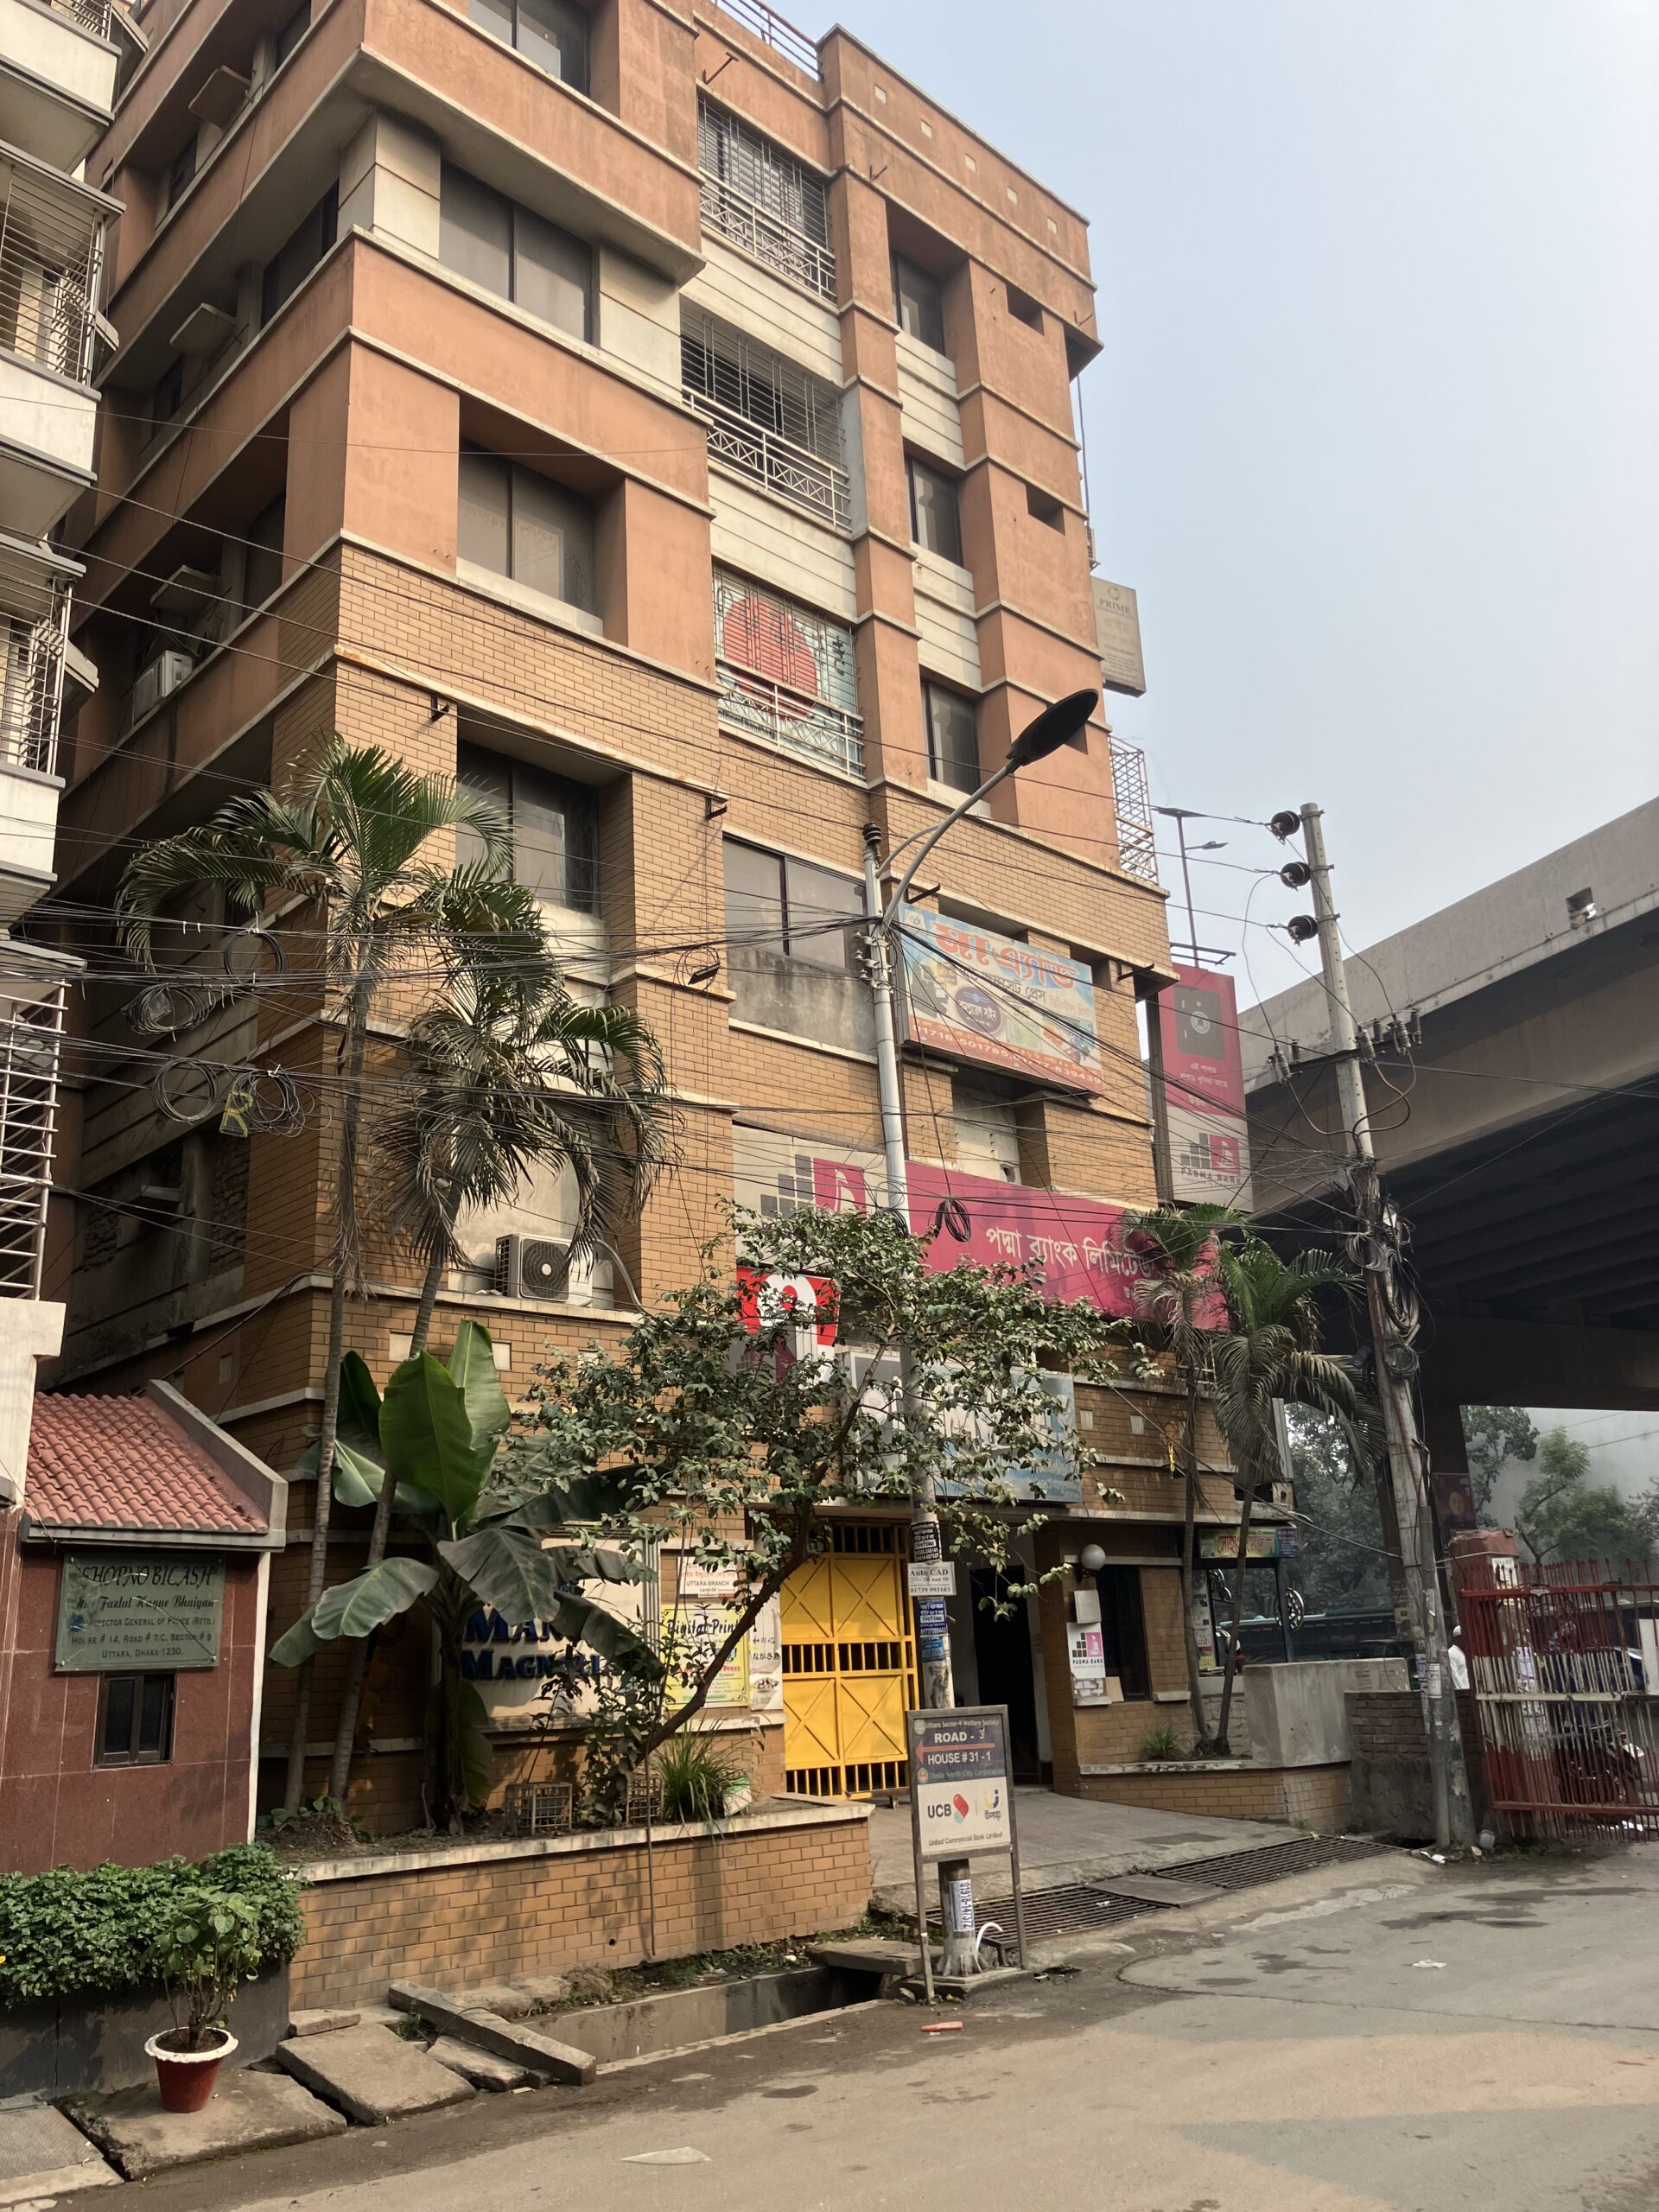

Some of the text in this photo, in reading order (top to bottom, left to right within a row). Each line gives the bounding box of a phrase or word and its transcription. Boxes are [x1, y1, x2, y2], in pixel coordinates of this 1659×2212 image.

[1099, 598, 1131, 615] PRIME
[1181, 1167, 1212, 1180] PADMA
[1217, 1173, 1242, 1184] BANK
[986, 1226, 1021, 1260] পদ্মা
[124, 1618, 156, 1626] GENERAL
[124, 1633, 143, 1643] ROAD
[934, 1732, 968, 1743] ROAD
[927, 1752, 961, 1764] HOUSE
[969, 1751, 979, 1763] 31
[927, 1803, 951, 1819] UCB
[944, 1834, 973, 1844] Commercial
[985, 1831, 1003, 1840] Limited
